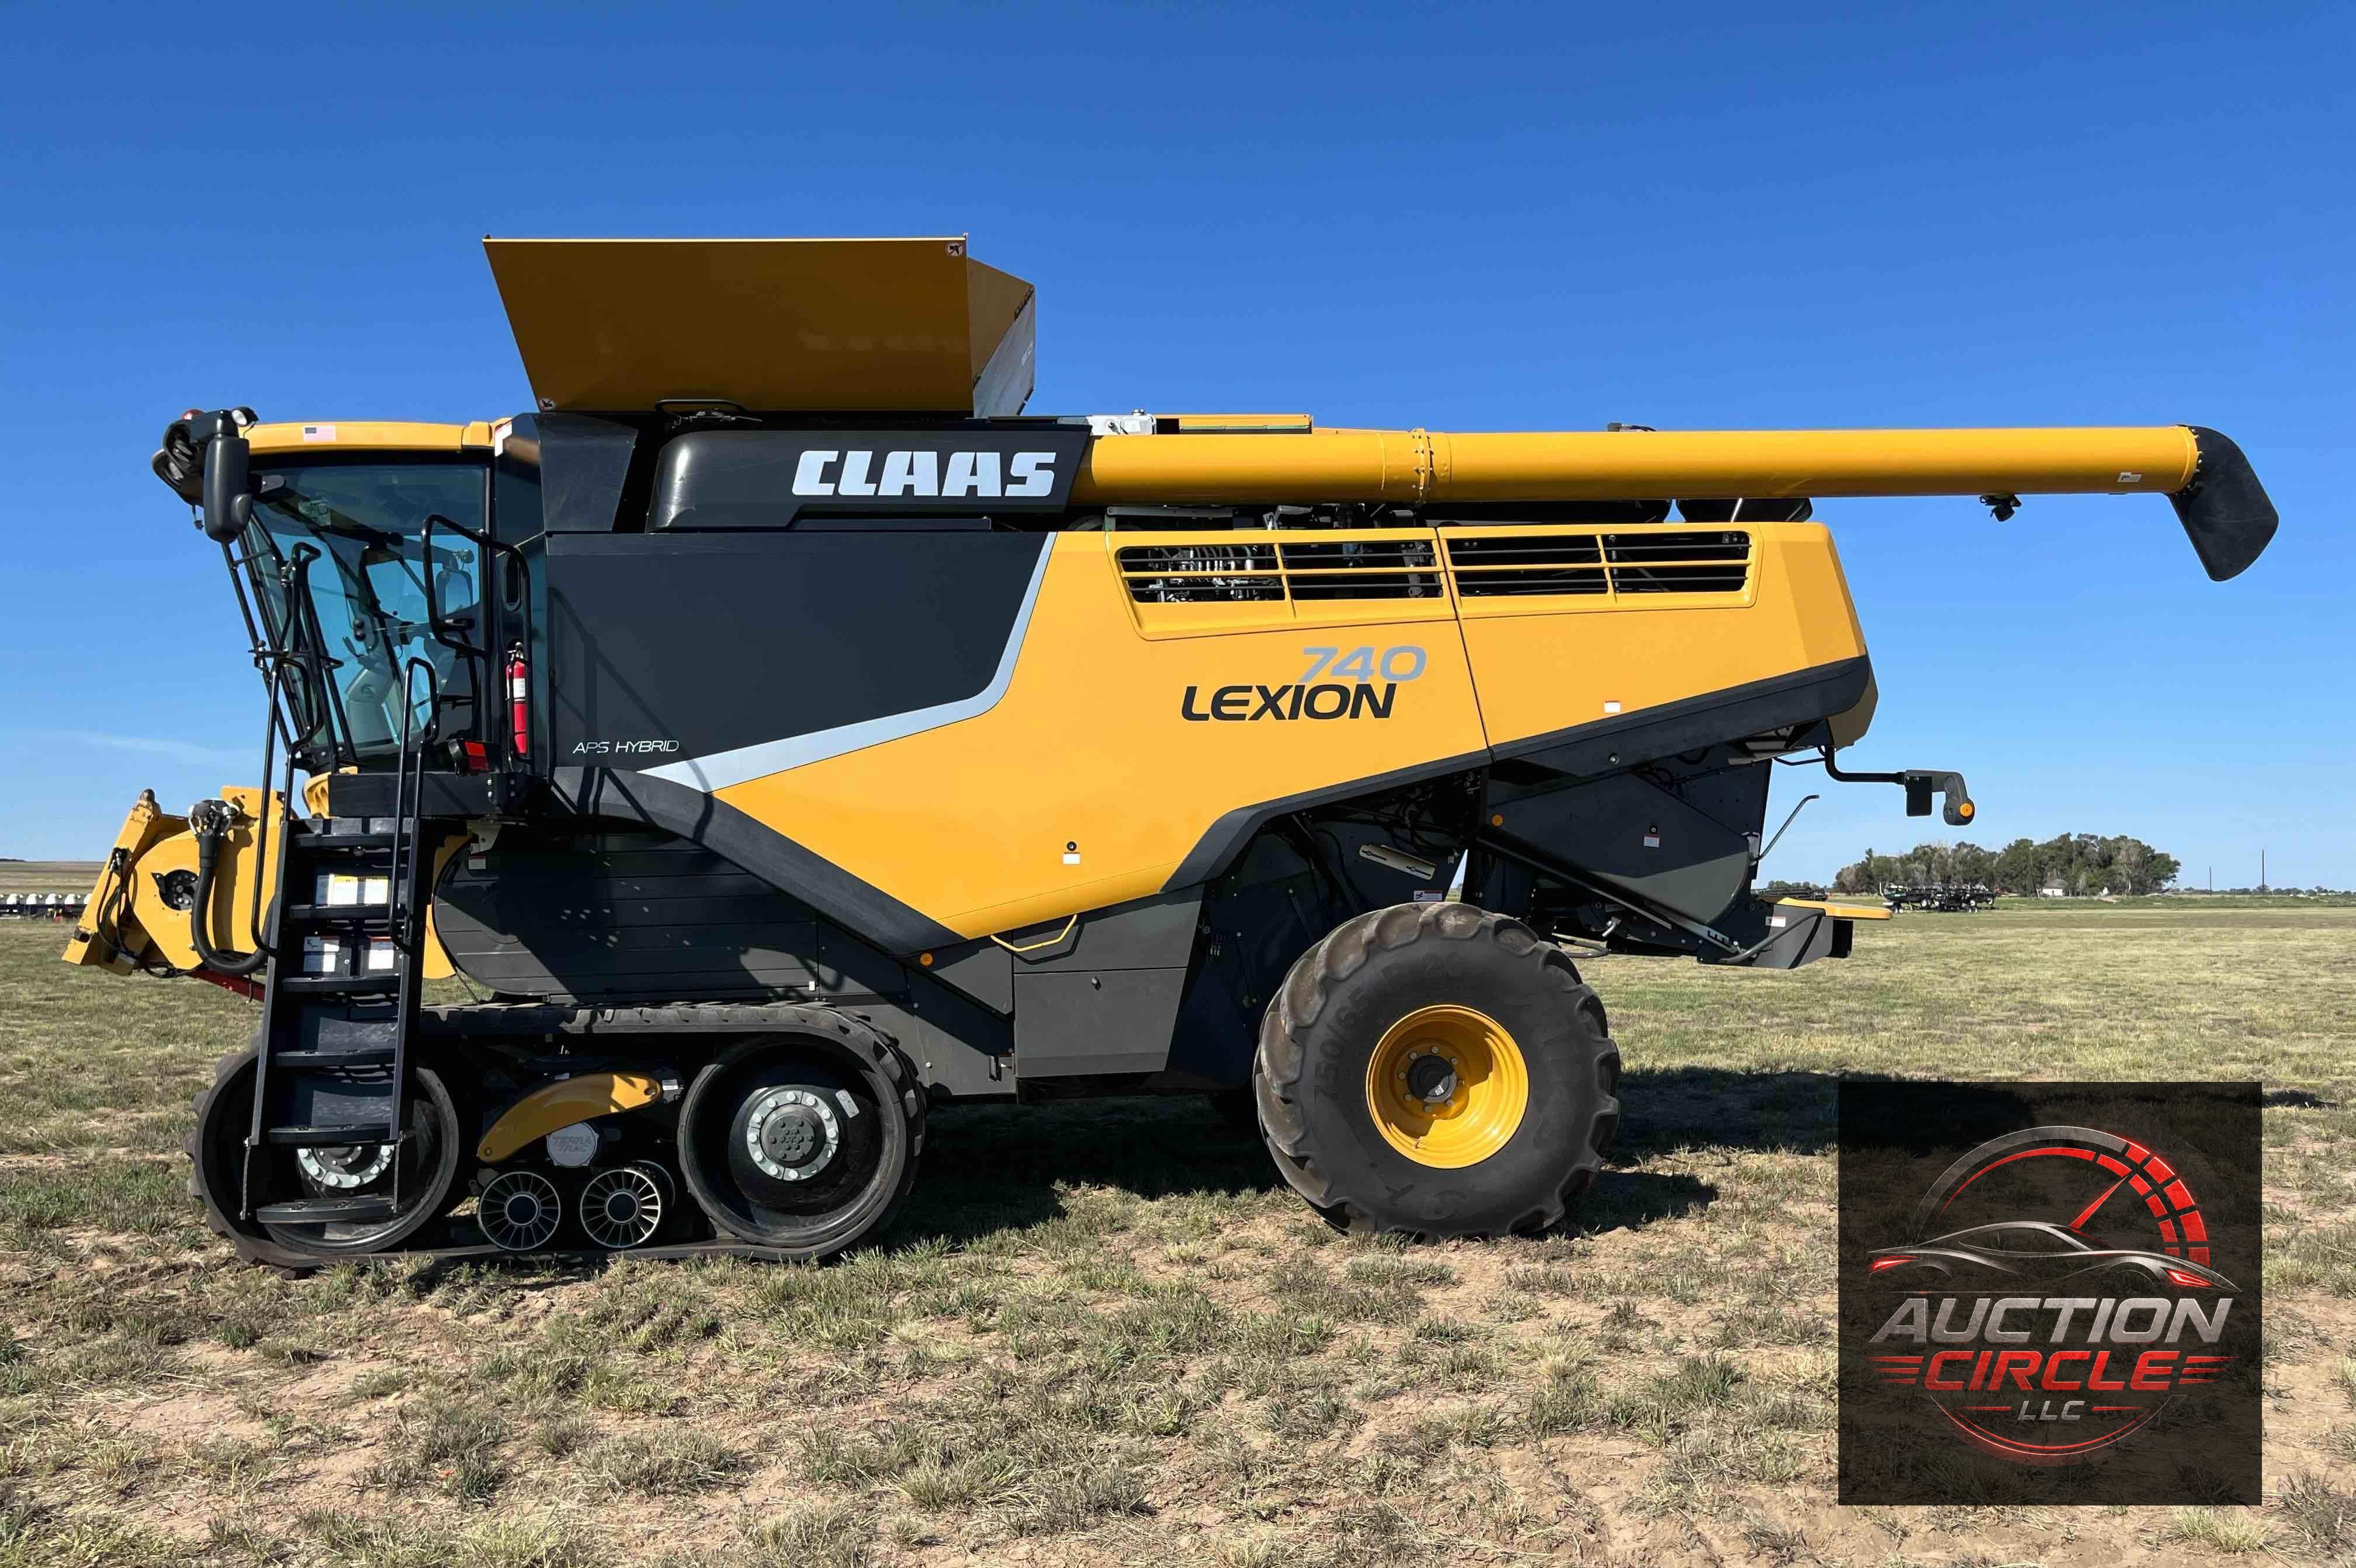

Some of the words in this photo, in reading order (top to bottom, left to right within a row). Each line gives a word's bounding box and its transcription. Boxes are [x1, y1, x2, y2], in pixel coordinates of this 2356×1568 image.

[792, 450, 1056, 497] CLAAS
[1297, 646, 1427, 683] 740
[1182, 683, 1397, 721] LEXION
[573, 741, 610, 754] APS
[615, 740, 680, 753] HYBRID
